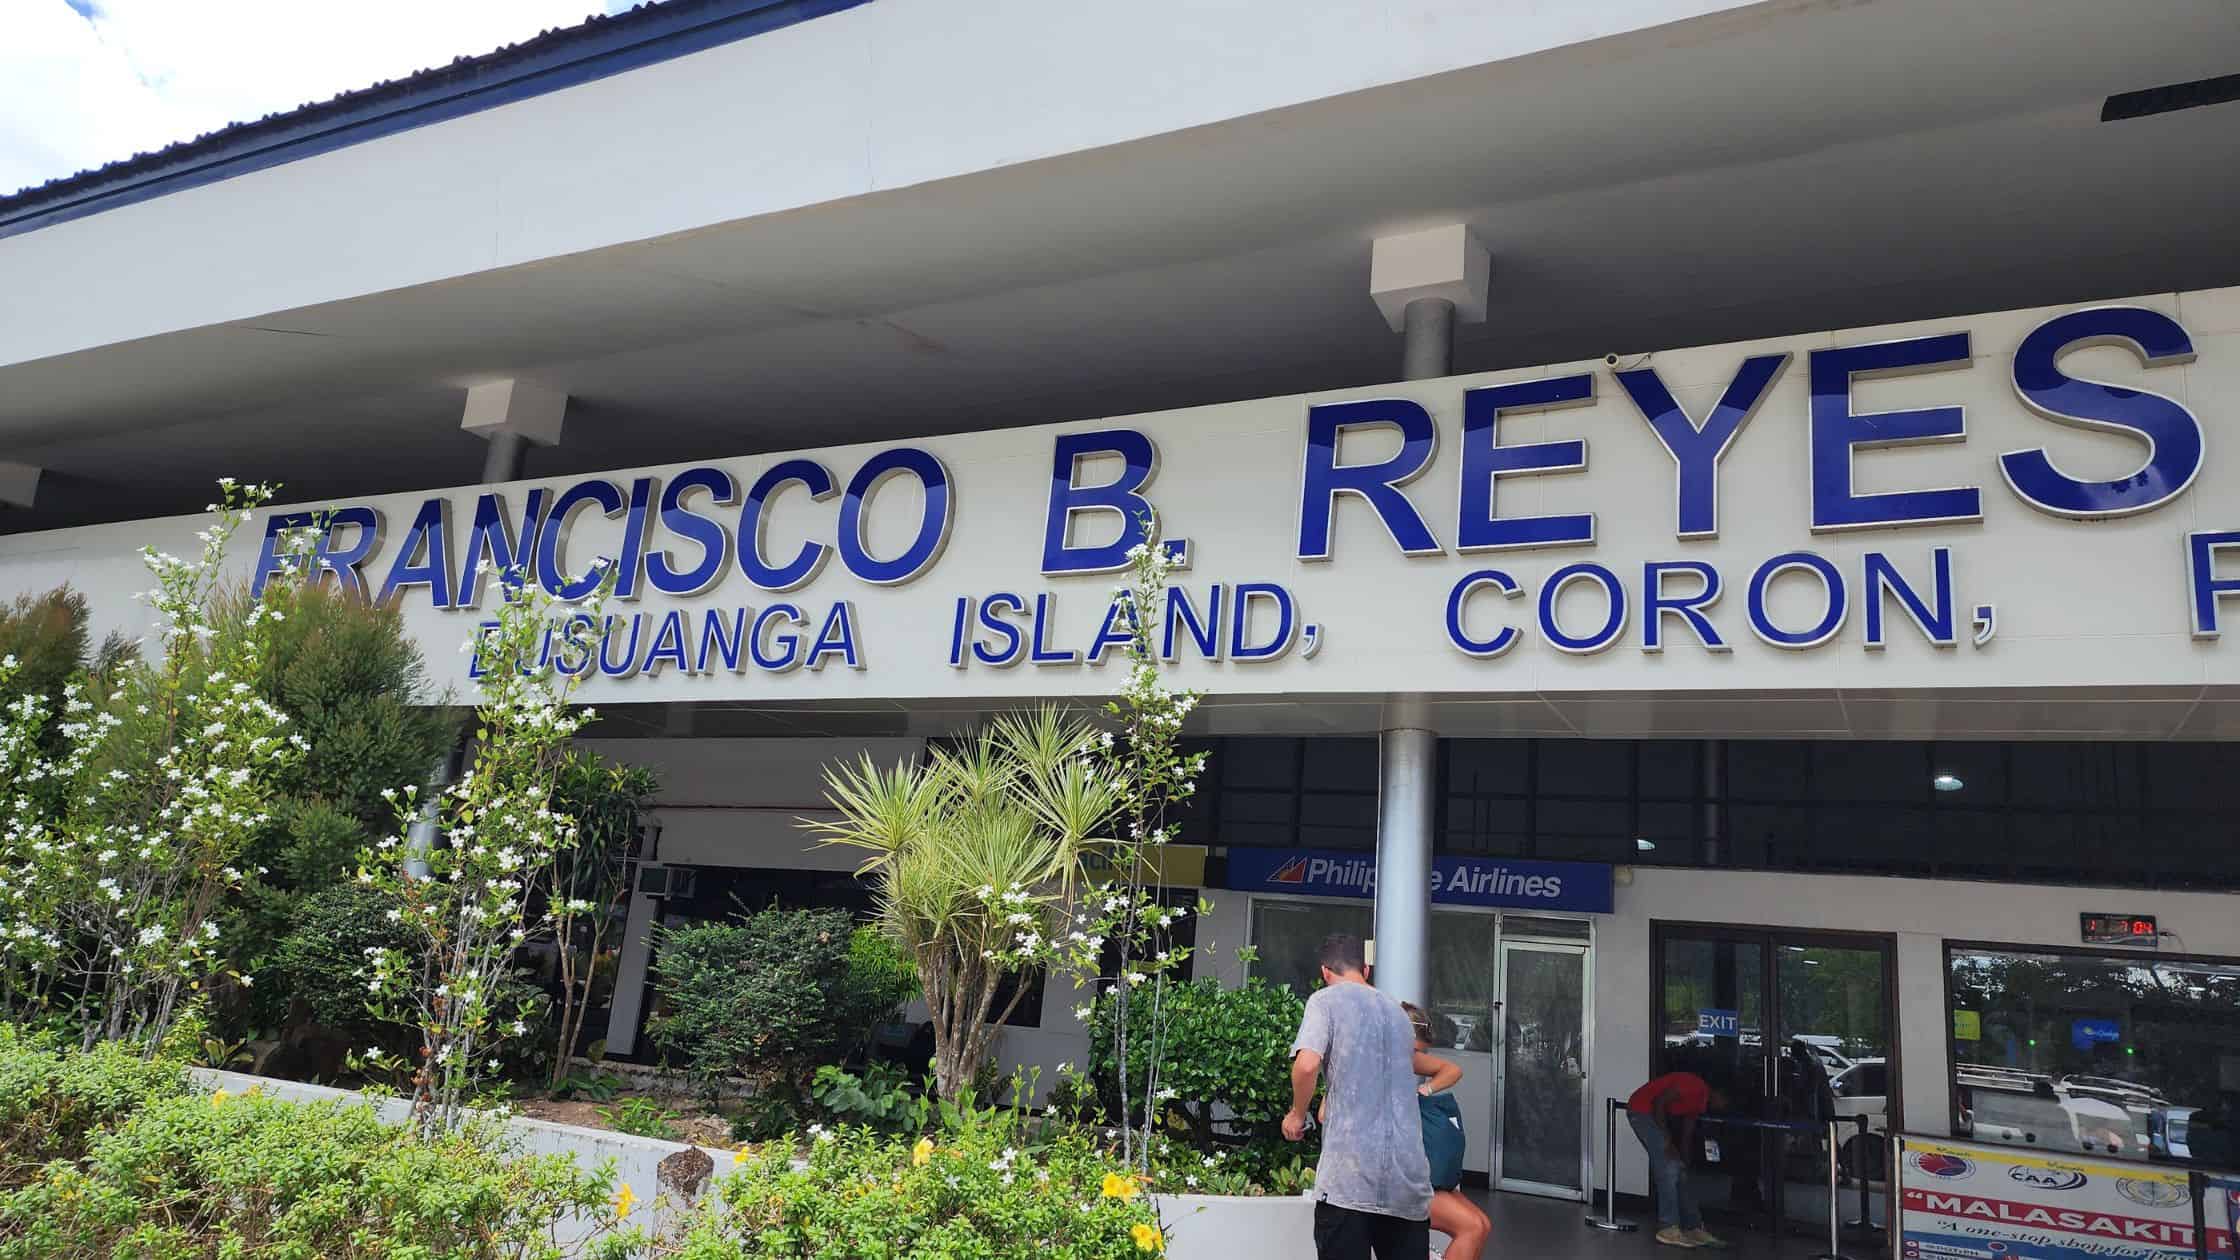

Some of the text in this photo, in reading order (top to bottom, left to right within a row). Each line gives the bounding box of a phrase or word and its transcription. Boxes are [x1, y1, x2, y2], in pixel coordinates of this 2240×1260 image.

[250, 305, 2206, 609] FRANCISCO B. REYES
[948, 582, 1321, 668] ISLAND,
[1445, 546, 1997, 660] CORON,
[1306, 857, 1562, 898] Philipe Airlines
[1699, 1014, 1737, 1031] EXIT
[1965, 1226, 2052, 1247] one-stop
